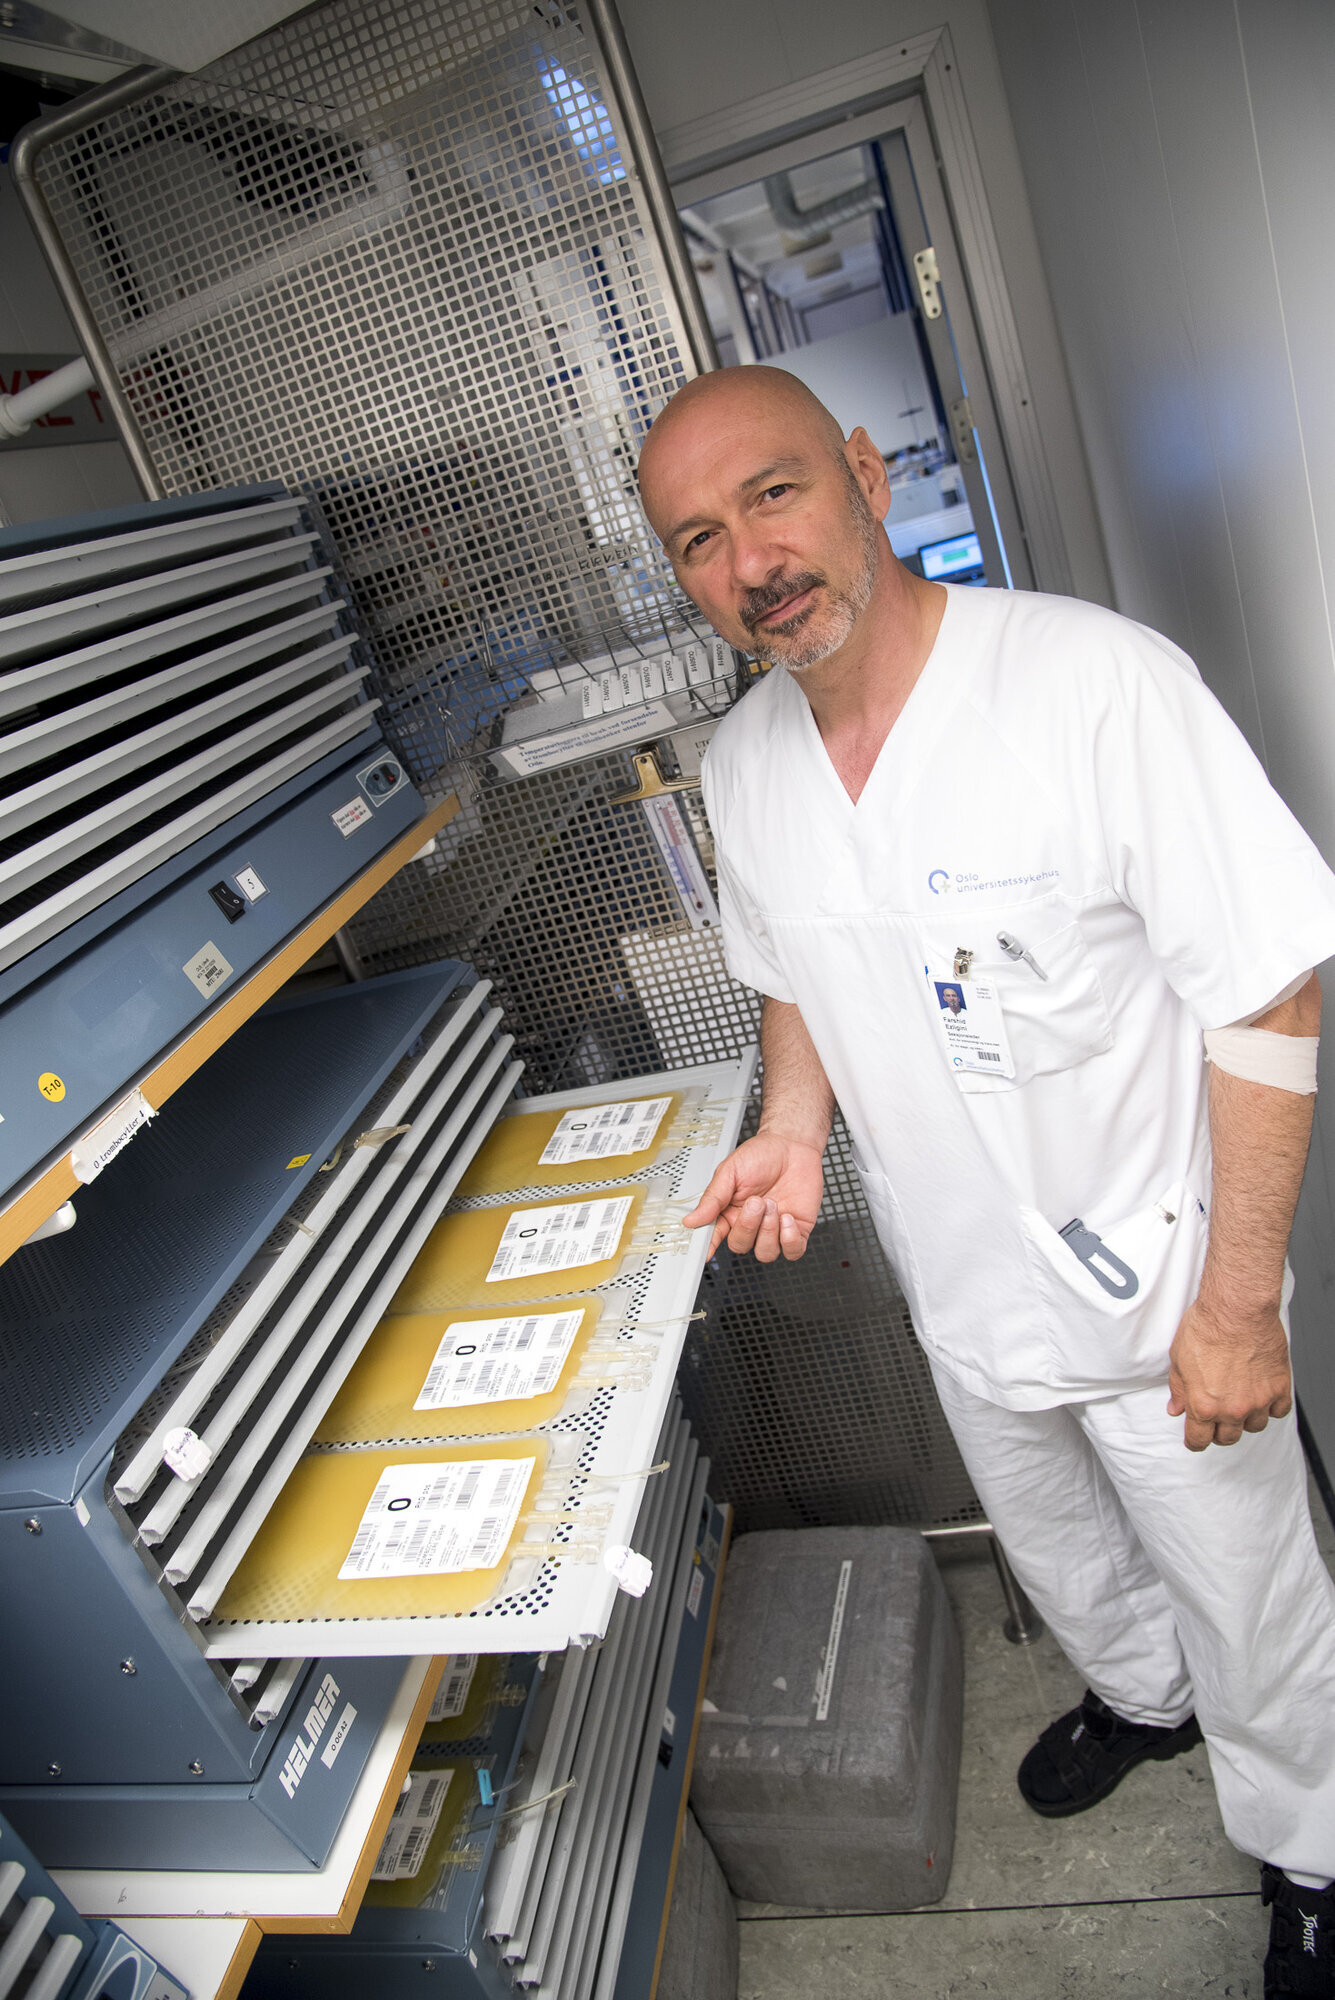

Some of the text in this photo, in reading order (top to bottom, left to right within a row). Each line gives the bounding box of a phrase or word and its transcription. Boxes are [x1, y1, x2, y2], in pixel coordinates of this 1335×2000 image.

[956, 873, 978, 882] Oslo
[957, 870, 1060, 893] universitetssykehus
[43, 1079, 62, 1096] T-10
[100, 1118, 139, 1161] trombocytter
[279, 1673, 340, 1800] HELMER
[334, 1732, 342, 1743] OG
[342, 1721, 348, 1732] A2
